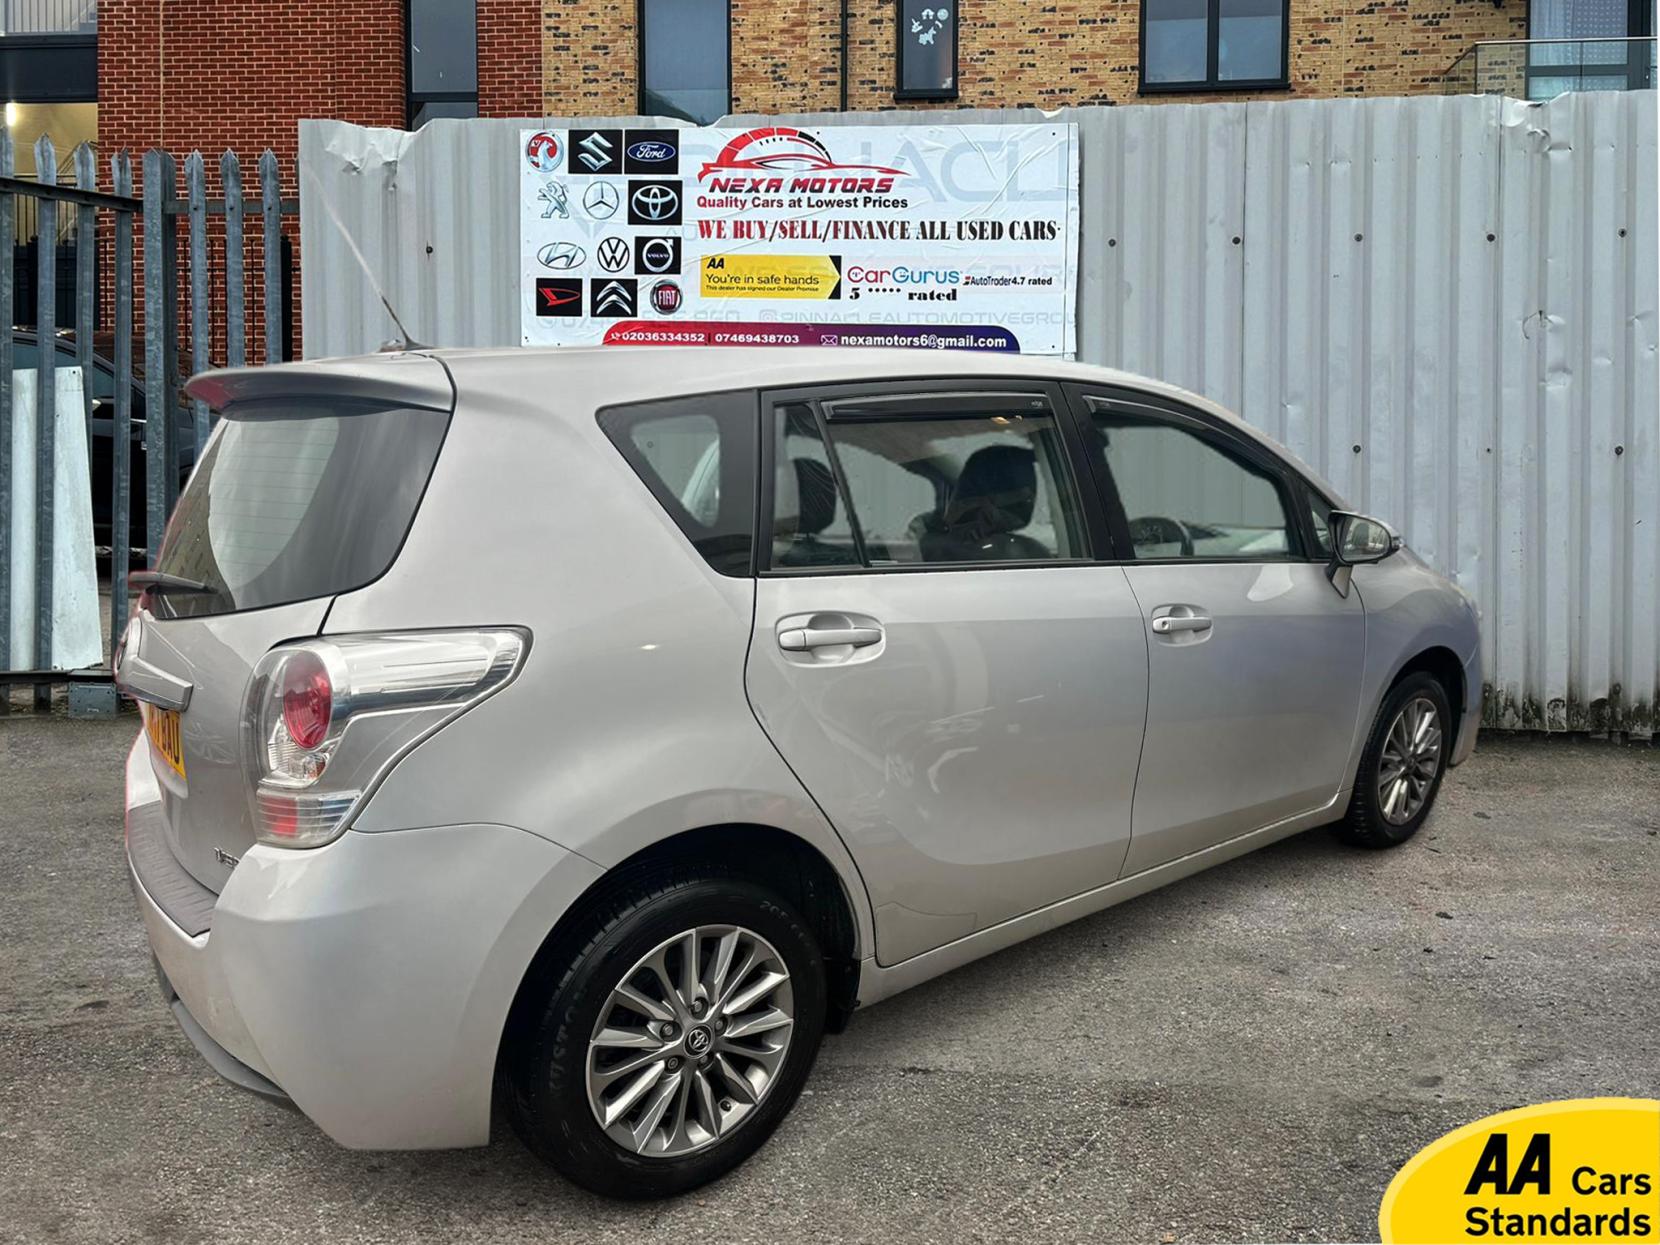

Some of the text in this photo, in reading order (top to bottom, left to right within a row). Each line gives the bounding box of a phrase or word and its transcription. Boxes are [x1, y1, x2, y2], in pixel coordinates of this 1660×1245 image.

[636, 141, 666, 159] Ford
[708, 178, 895, 194] NEXA MOTORS
[696, 196, 909, 210] Quality Cars at Lowest Prices
[697, 219, 727, 240] WE
[733, 219, 911, 243] BUY/SELL/FINANCE
[916, 219, 951, 241] ALL
[956, 219, 1004, 241] USED
[706, 257, 725, 269] AA
[705, 274, 820, 285] You're in safe hands
[847, 265, 960, 284] CarGurus
[1028, 276, 1053, 286] rated
[658, 290, 677, 306] FIAT
[849, 287, 958, 301] 5 rated
[622, 332, 705, 342] 02036334352
[715, 334, 800, 344] 07469438703
[840, 334, 1007, 349] nexamotors6@gmail.com
